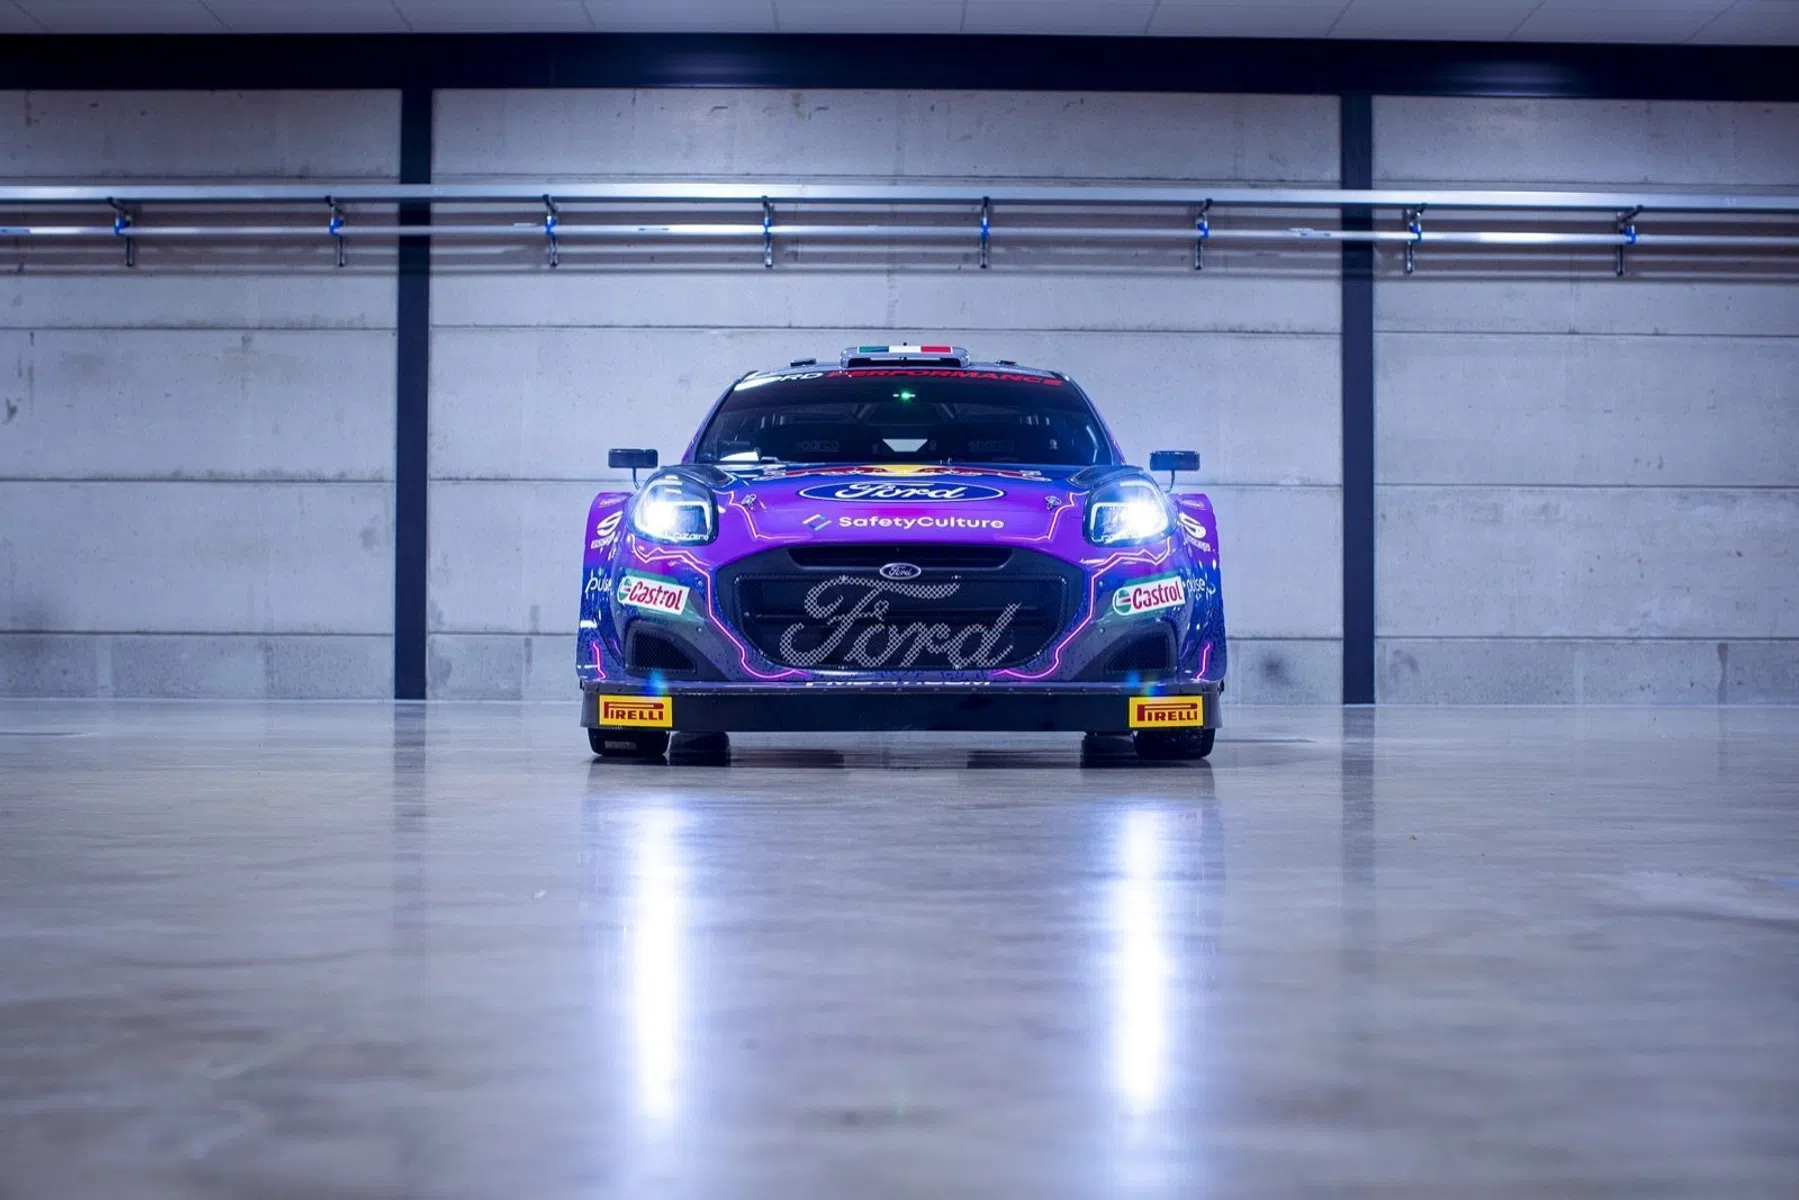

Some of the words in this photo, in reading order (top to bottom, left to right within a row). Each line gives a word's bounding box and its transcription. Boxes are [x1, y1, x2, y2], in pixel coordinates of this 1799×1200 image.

[834, 481, 968, 499] Ford
[838, 515, 1005, 530] SafetyCulture
[888, 565, 913, 577] Ford
[628, 581, 683, 610] Castrol
[1131, 580, 1183, 610] Castrol
[779, 575, 1022, 668] Ford
[603, 701, 665, 720] PIRELLI
[1136, 702, 1198, 722] PIRELLI
